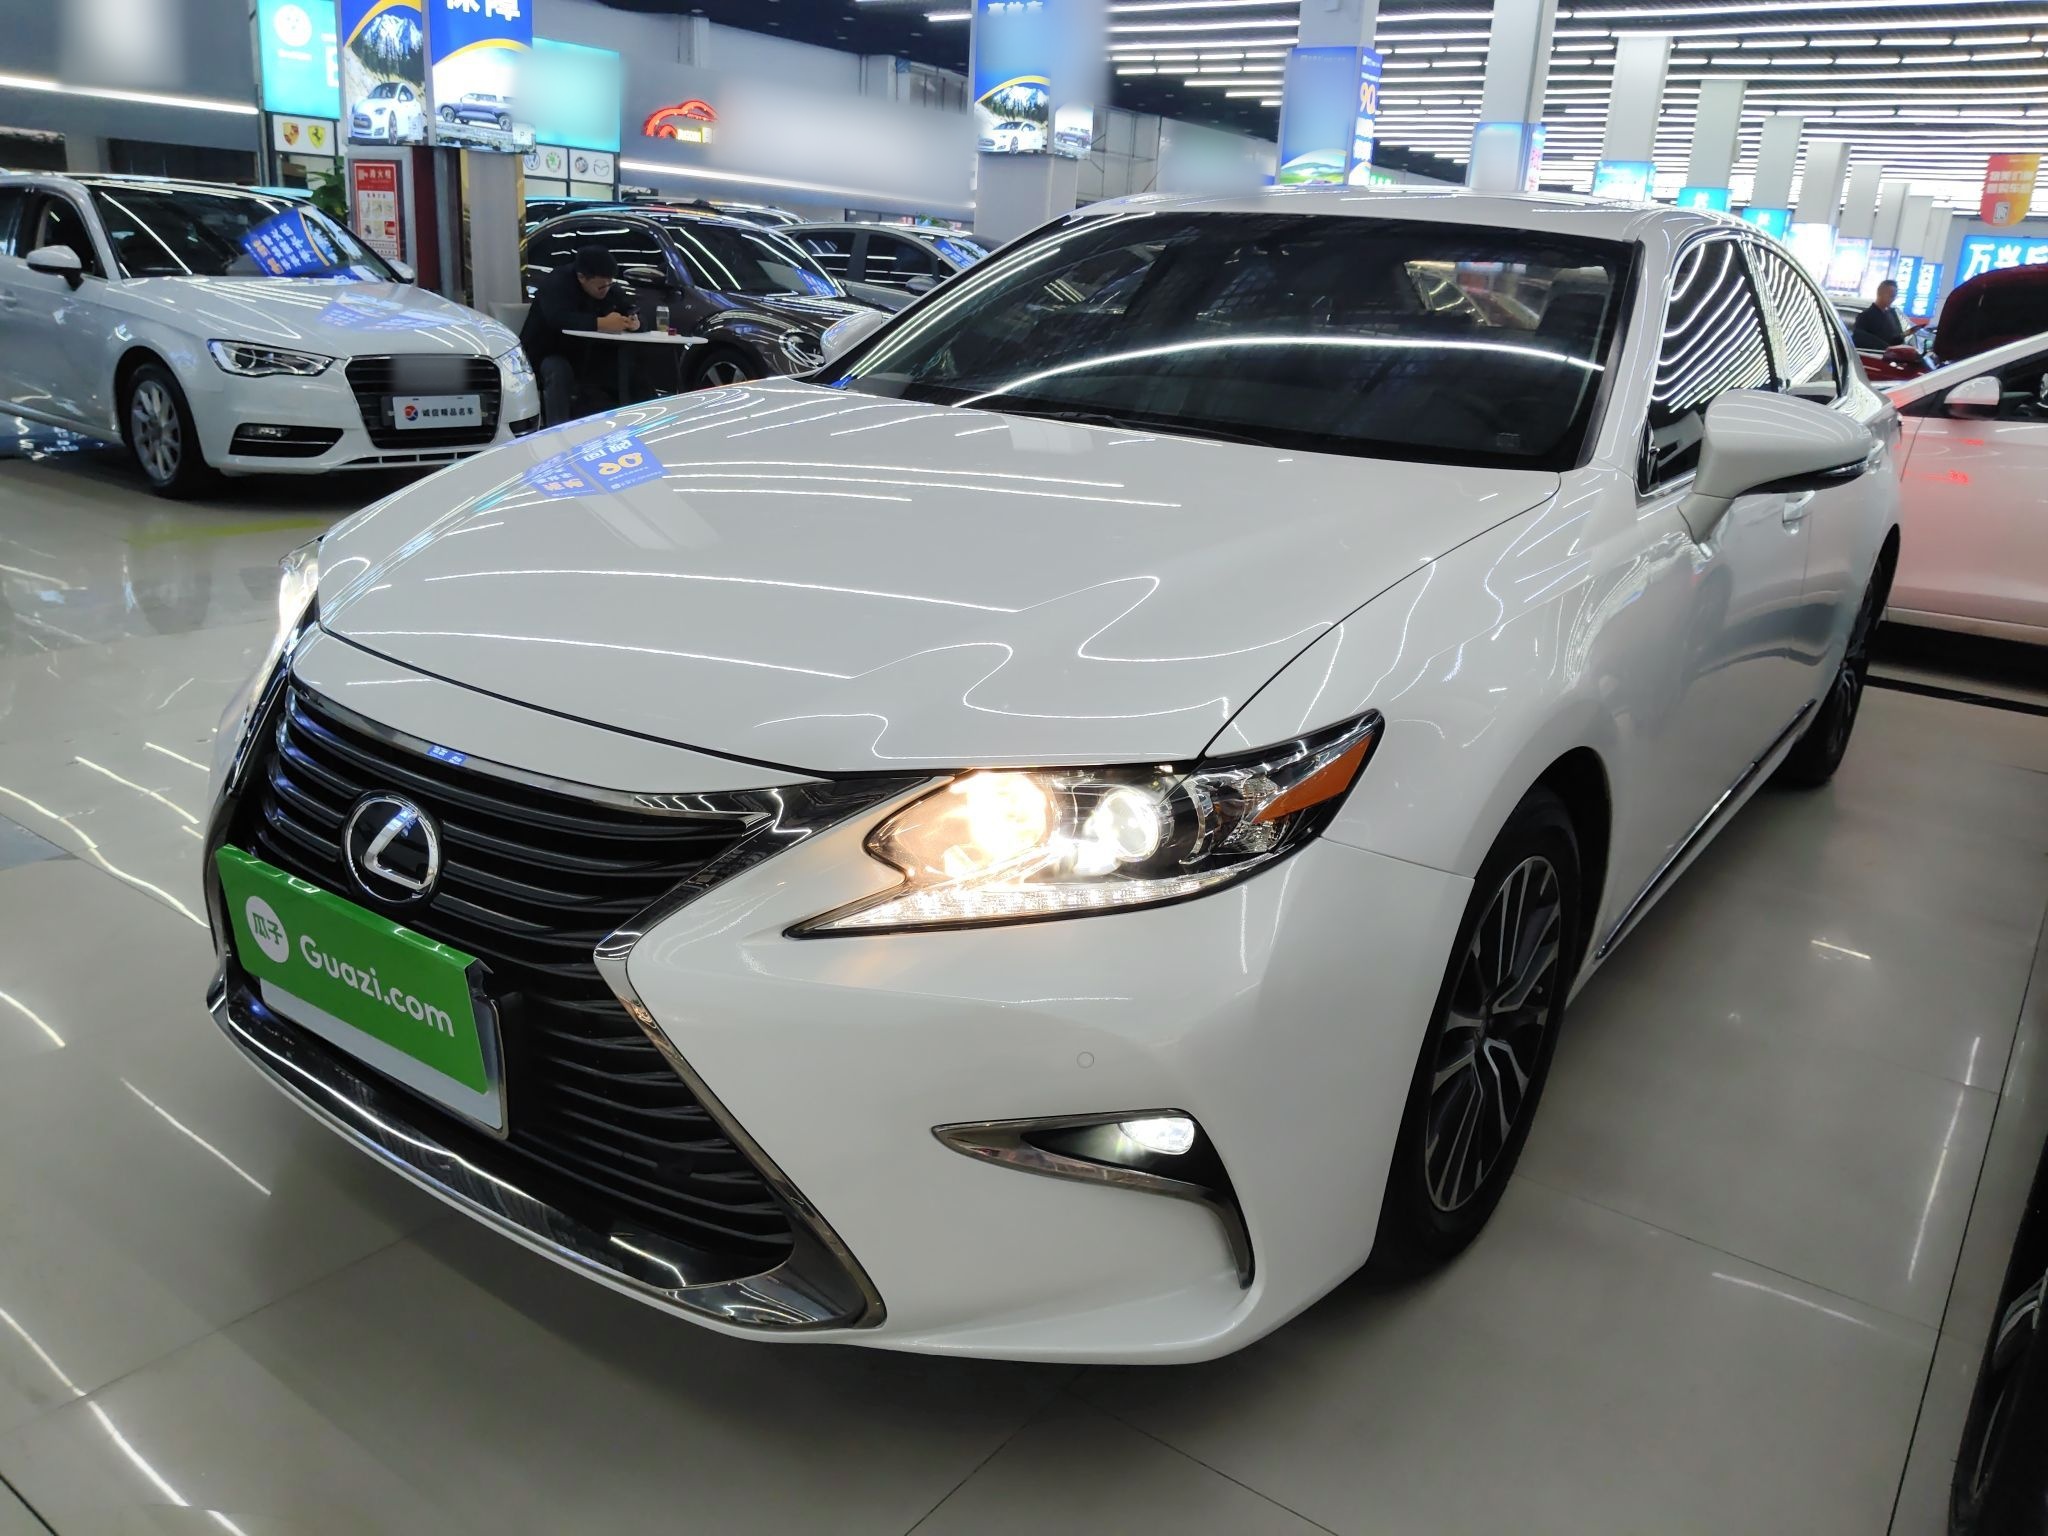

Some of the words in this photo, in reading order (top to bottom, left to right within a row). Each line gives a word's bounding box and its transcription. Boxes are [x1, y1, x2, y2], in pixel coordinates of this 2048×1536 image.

[1360, 81, 1376, 115] 90
[252, 912, 283, 945] 瓜子
[300, 935, 455, 1038] Guazi.com
